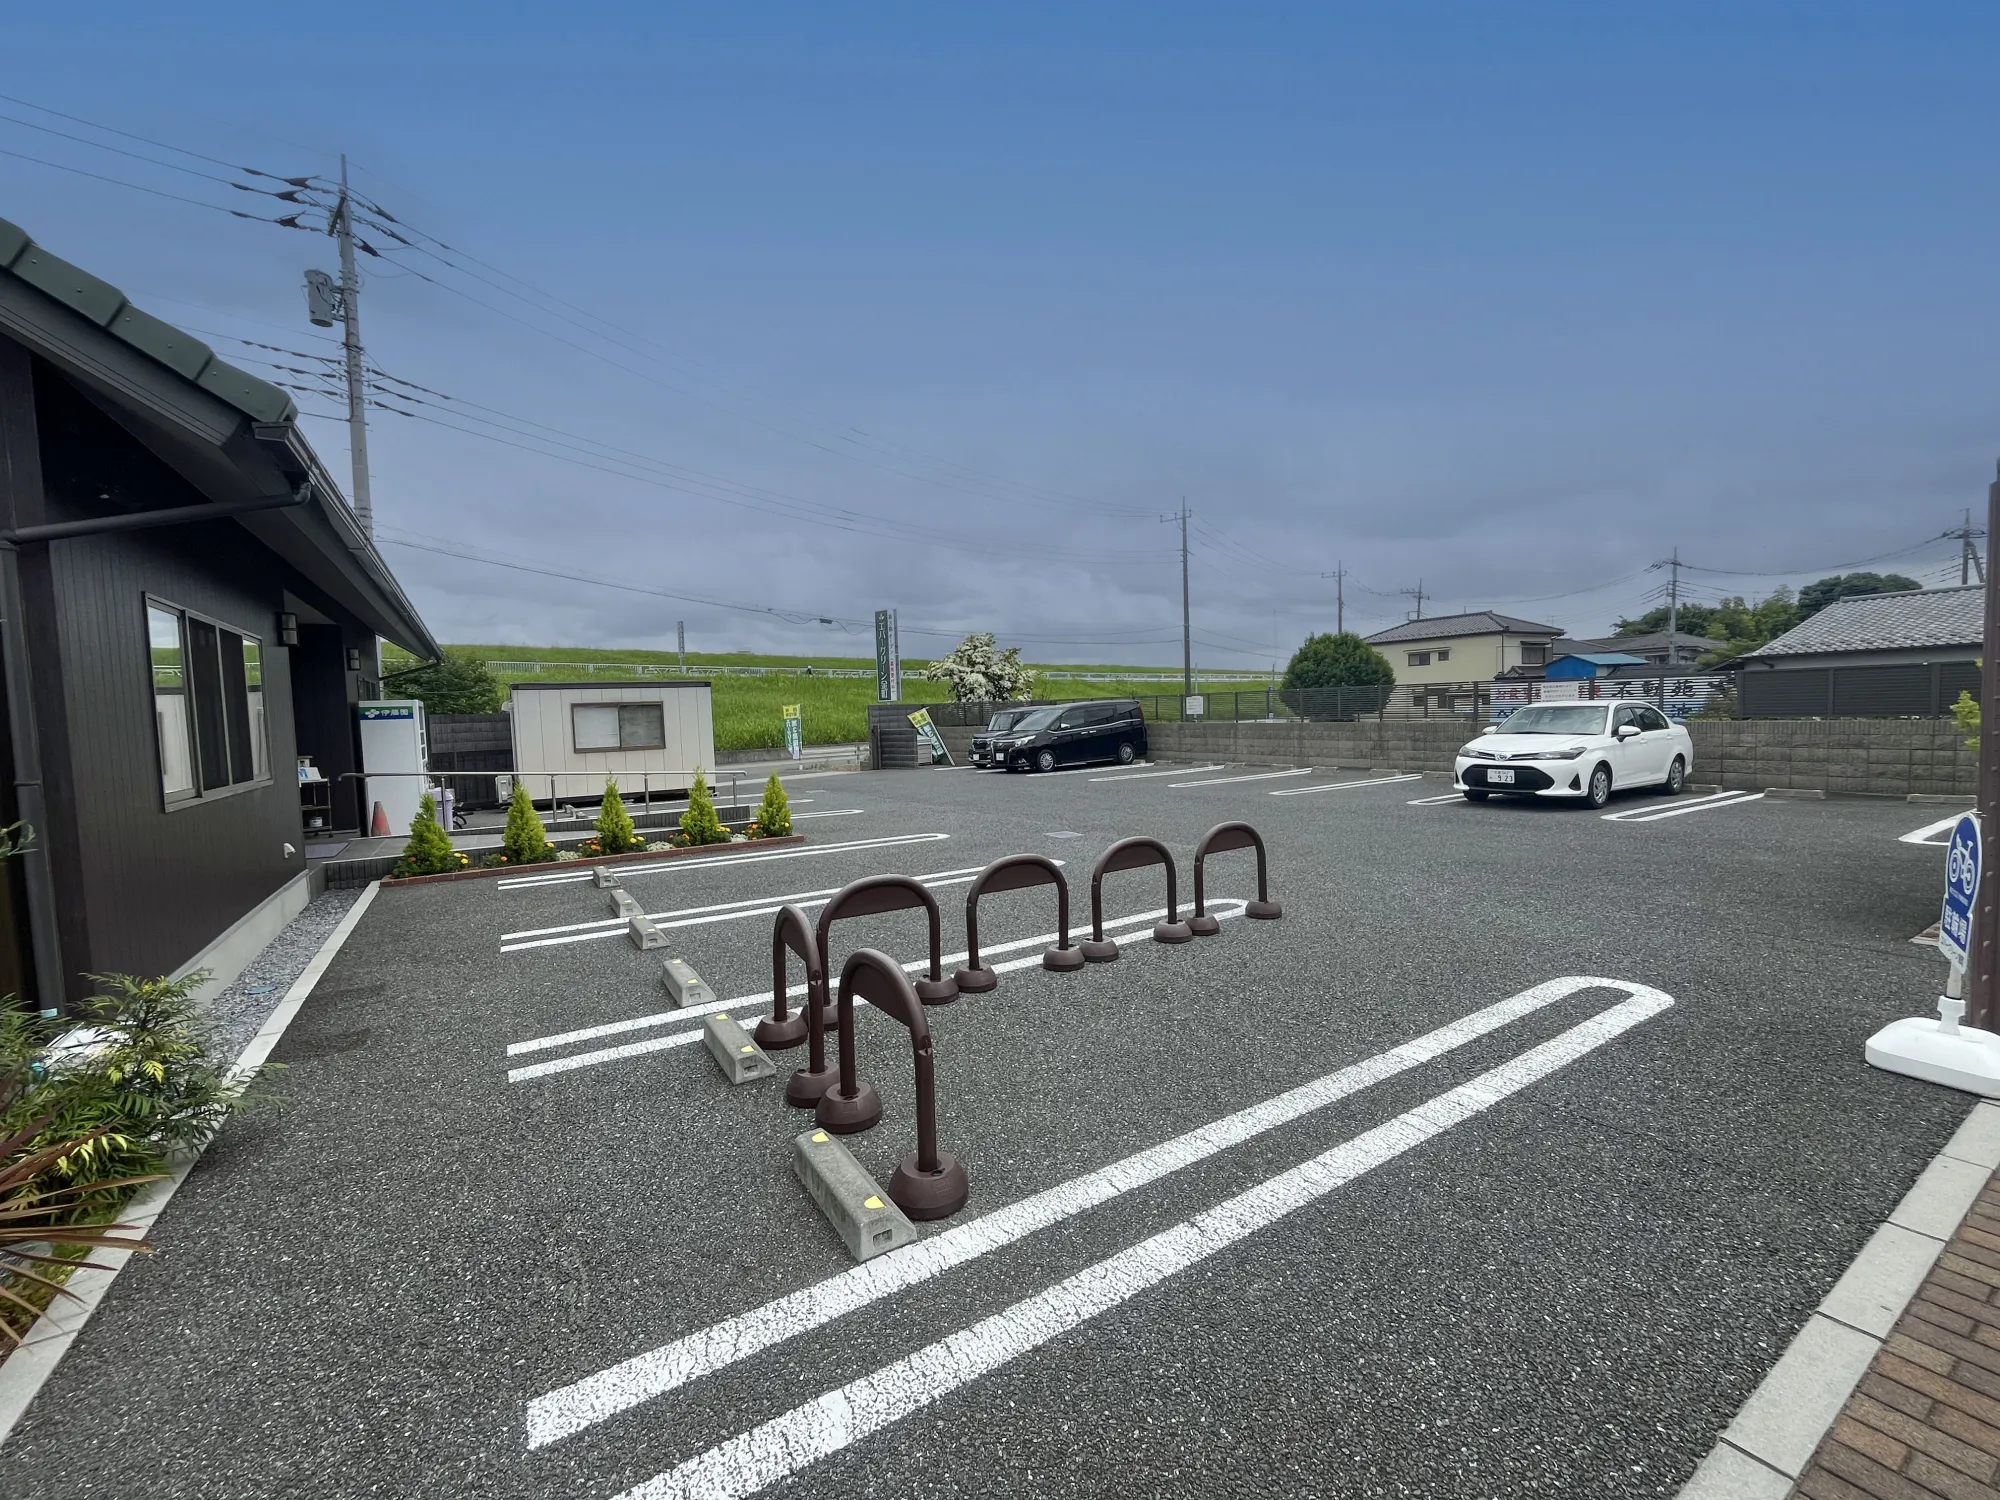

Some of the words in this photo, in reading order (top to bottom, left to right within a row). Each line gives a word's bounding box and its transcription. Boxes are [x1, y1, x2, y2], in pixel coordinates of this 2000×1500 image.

[878, 622, 888, 699] エバーグリーン金町
